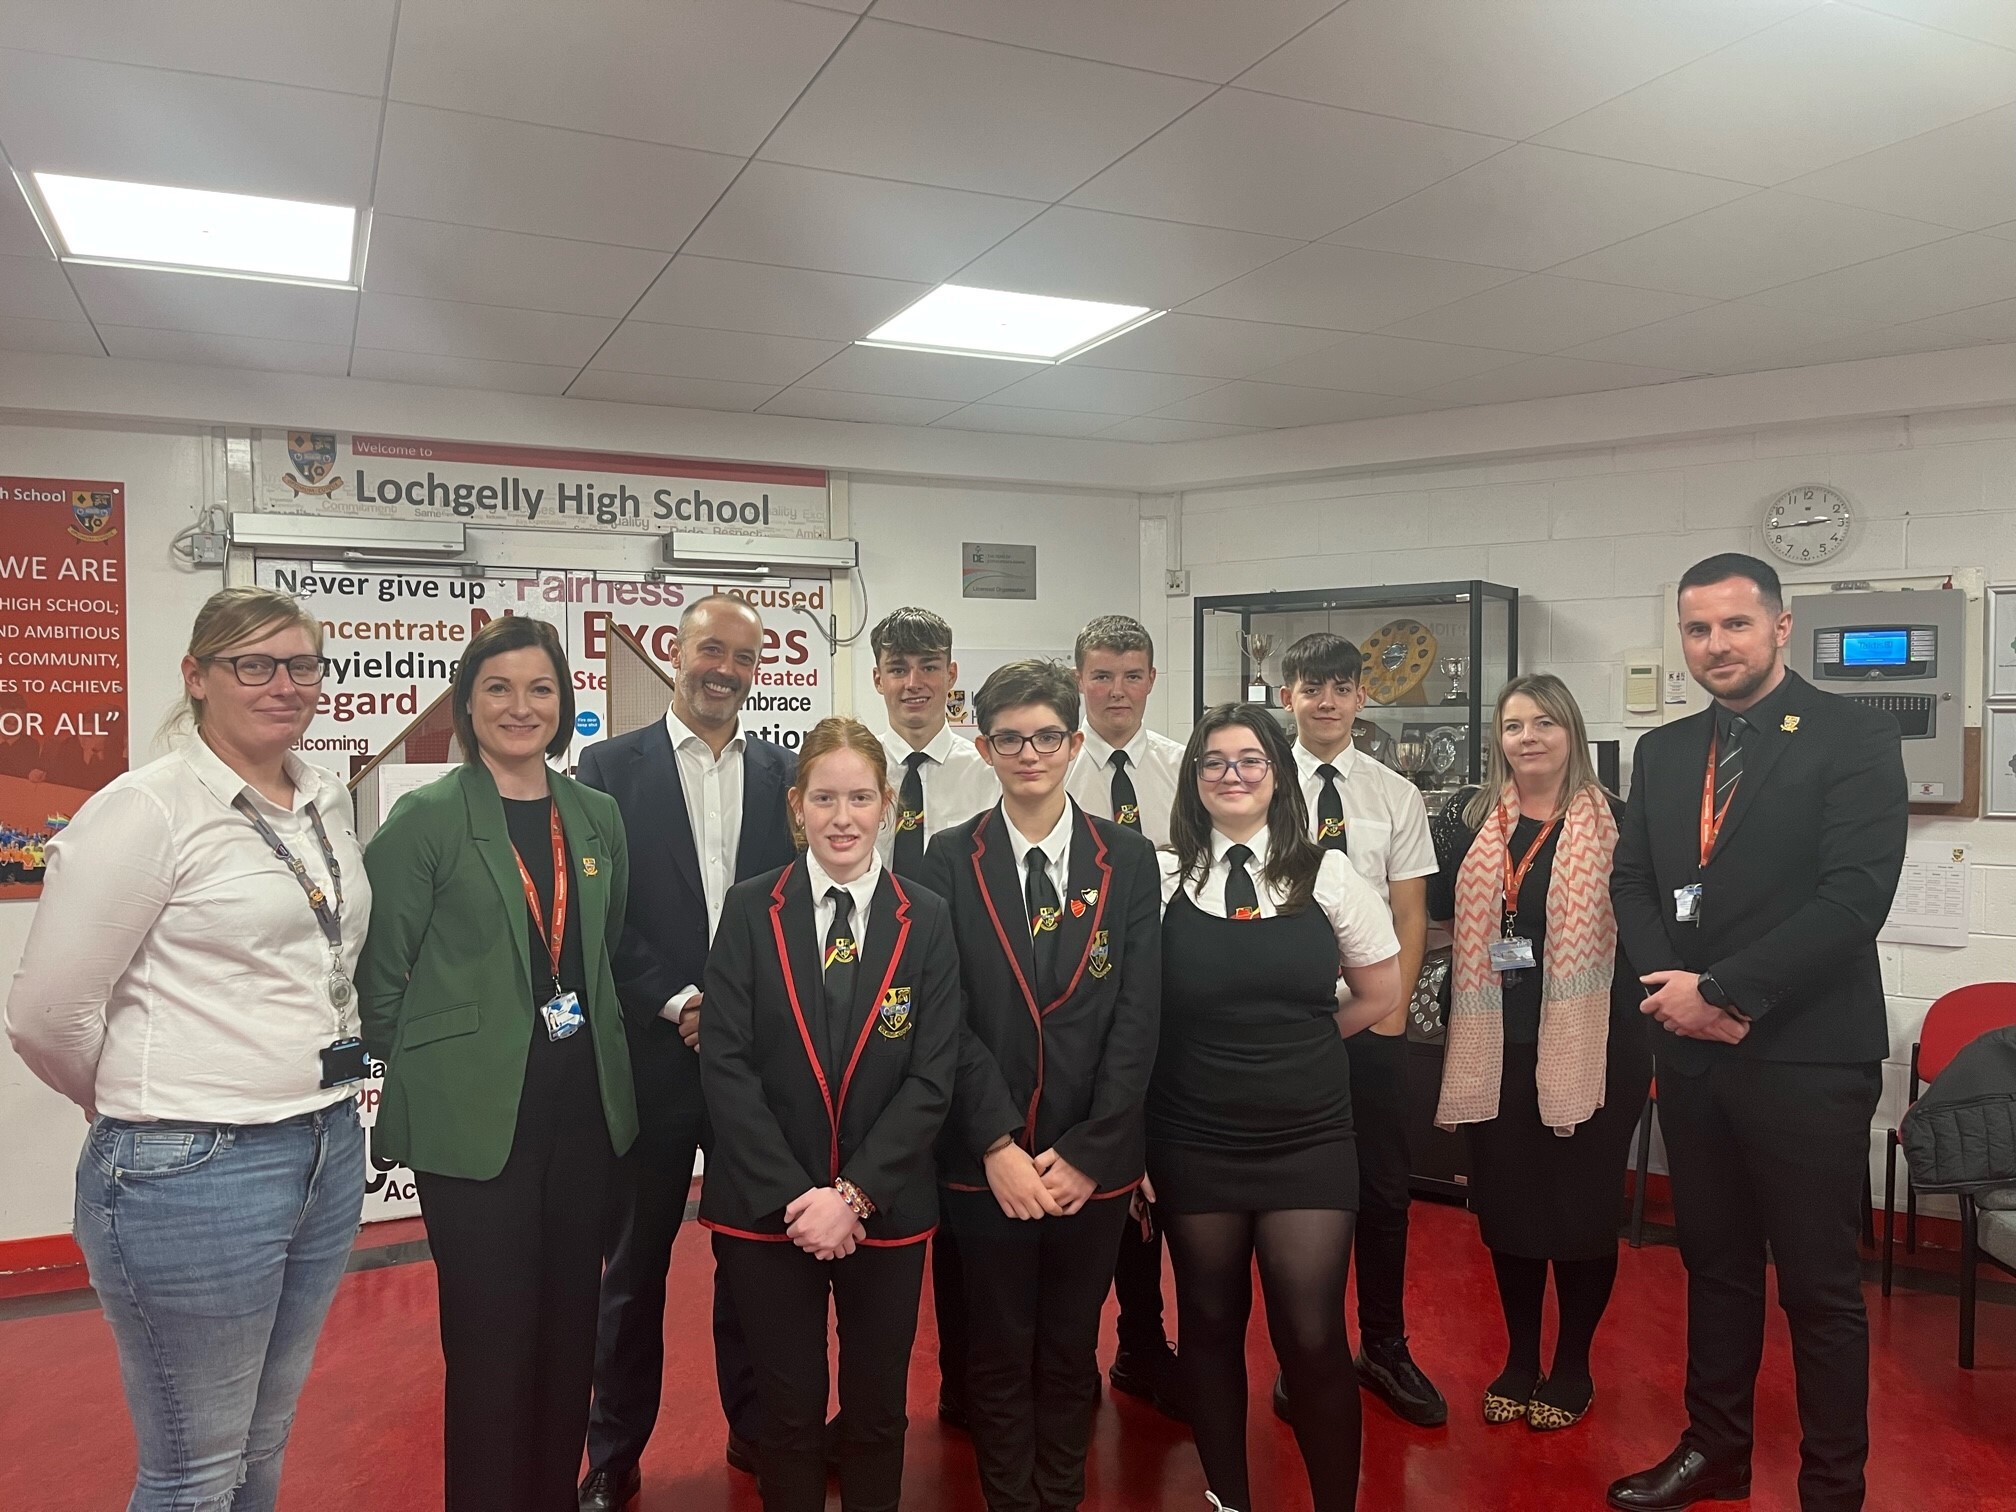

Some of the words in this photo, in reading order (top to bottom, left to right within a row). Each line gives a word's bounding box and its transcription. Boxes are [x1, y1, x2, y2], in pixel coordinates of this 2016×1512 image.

[356, 441, 416, 457] Welcome
[420, 448, 433, 458] to
[14, 488, 66, 502] School
[356, 469, 544, 520] Lochgelly
[558, 483, 640, 524] High
[653, 489, 770, 525] School
[1788, 495, 1797, 505] 11
[1803, 490, 1814, 500] 12
[322, 500, 397, 514] Commitment
[1775, 506, 1785, 515] 10
[1832, 503, 1841, 513] 2
[414, 508, 442, 518] Same
[1837, 517, 1845, 527] 3
[1775, 534, 1783, 543] 8
[1830, 532, 1838, 542] 4
[1786, 544, 1794, 554] 7
[1801, 548, 1810, 557] 6
[1819, 543, 1827, 553] 5
[0, 555, 47, 579] WE
[57, 557, 118, 582] ARE
[275, 569, 369, 595] Never
[378, 574, 439, 601] give
[449, 580, 485, 604] up
[516, 575, 685, 607] Fairness
[0, 598, 41, 611] HIGH
[46, 599, 119, 615] SCHOOL;
[24, 625, 120, 640] AMBITIOUS
[8, 652, 120, 669] COMMUNITY,
[22, 680, 45, 692] TO
[49, 680, 121, 693] ACHIEVE
